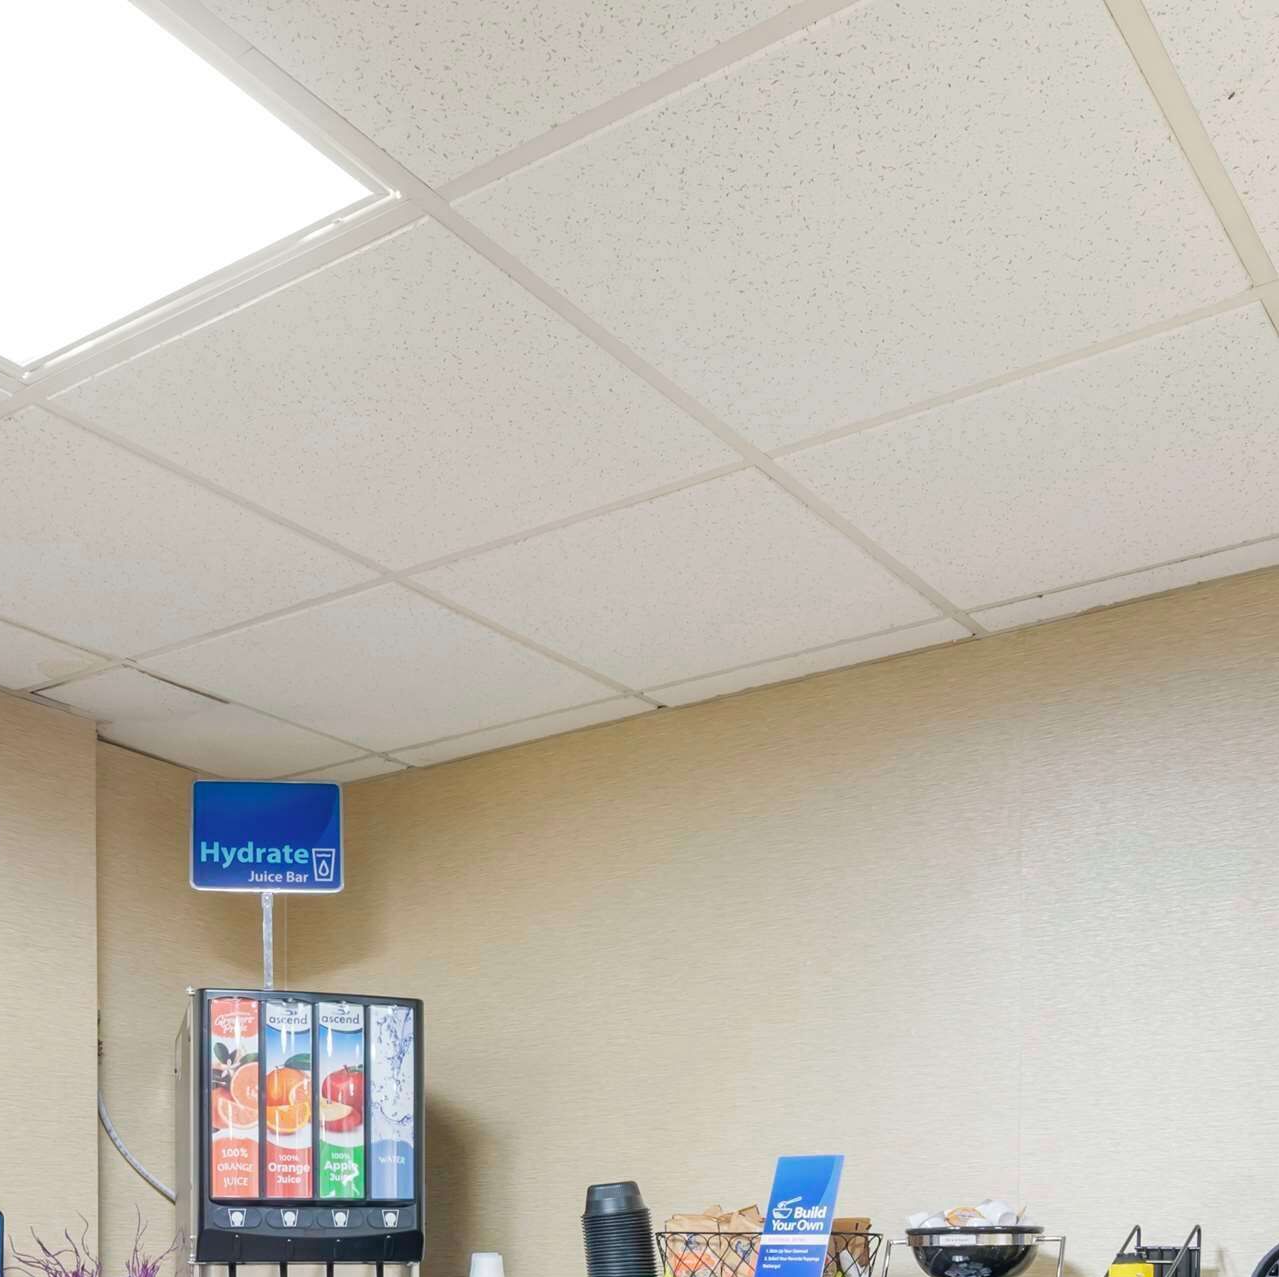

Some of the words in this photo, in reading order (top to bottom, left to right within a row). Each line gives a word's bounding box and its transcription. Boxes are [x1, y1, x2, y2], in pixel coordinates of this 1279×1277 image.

[200, 841, 309, 869] Hydrate
[248, 871, 283, 882] Juice
[286, 872, 308, 882] Bar
[269, 1014, 308, 1025] ascend
[321, 1014, 359, 1024] ascend
[222, 1148, 248, 1158] 100%
[279, 1154, 300, 1162] 100%
[378, 1156, 406, 1164] WATER
[217, 1163, 255, 1172] ORANGE
[268, 1162, 310, 1175] Orange
[224, 1176, 248, 1187] JUICE
[276, 1175, 302, 1184] Juice
[794, 1206, 827, 1219] Build
[772, 1219, 797, 1231] Your
[797, 1219, 824, 1231] Own
